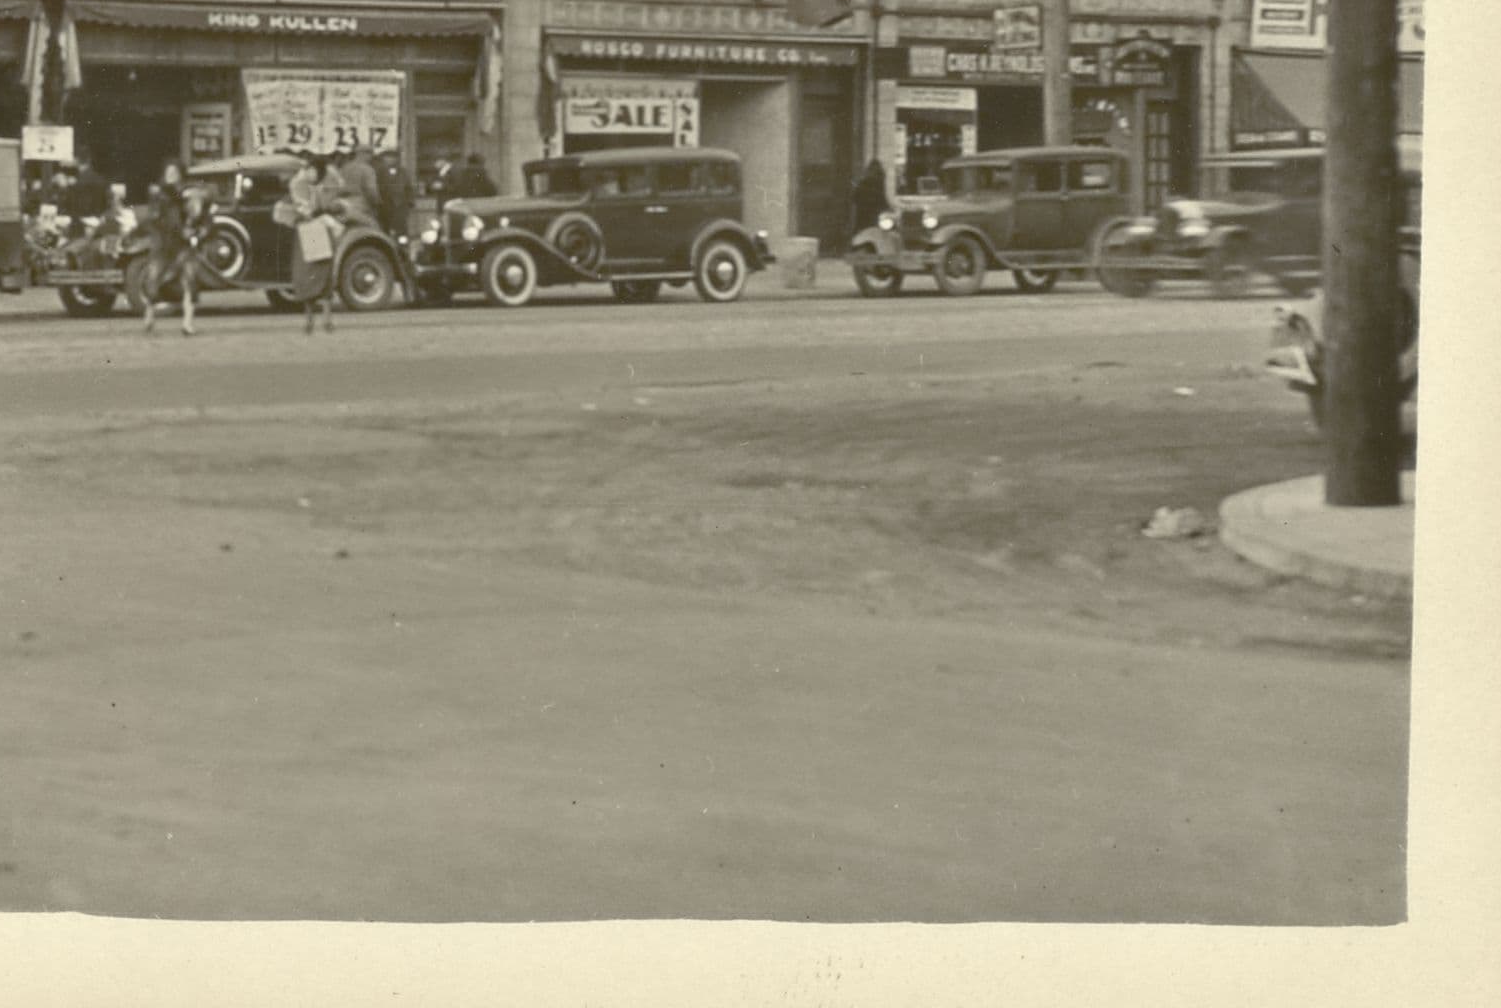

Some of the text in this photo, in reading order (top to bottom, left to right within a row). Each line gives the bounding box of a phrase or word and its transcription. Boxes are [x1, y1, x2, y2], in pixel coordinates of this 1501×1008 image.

[208, 12, 358, 31] KING KULLEN
[581, 40, 644, 57] ROSCO
[656, 44, 766, 63] FURNITURE
[575, 101, 669, 130] SALE
[287, 123, 313, 144] 29
